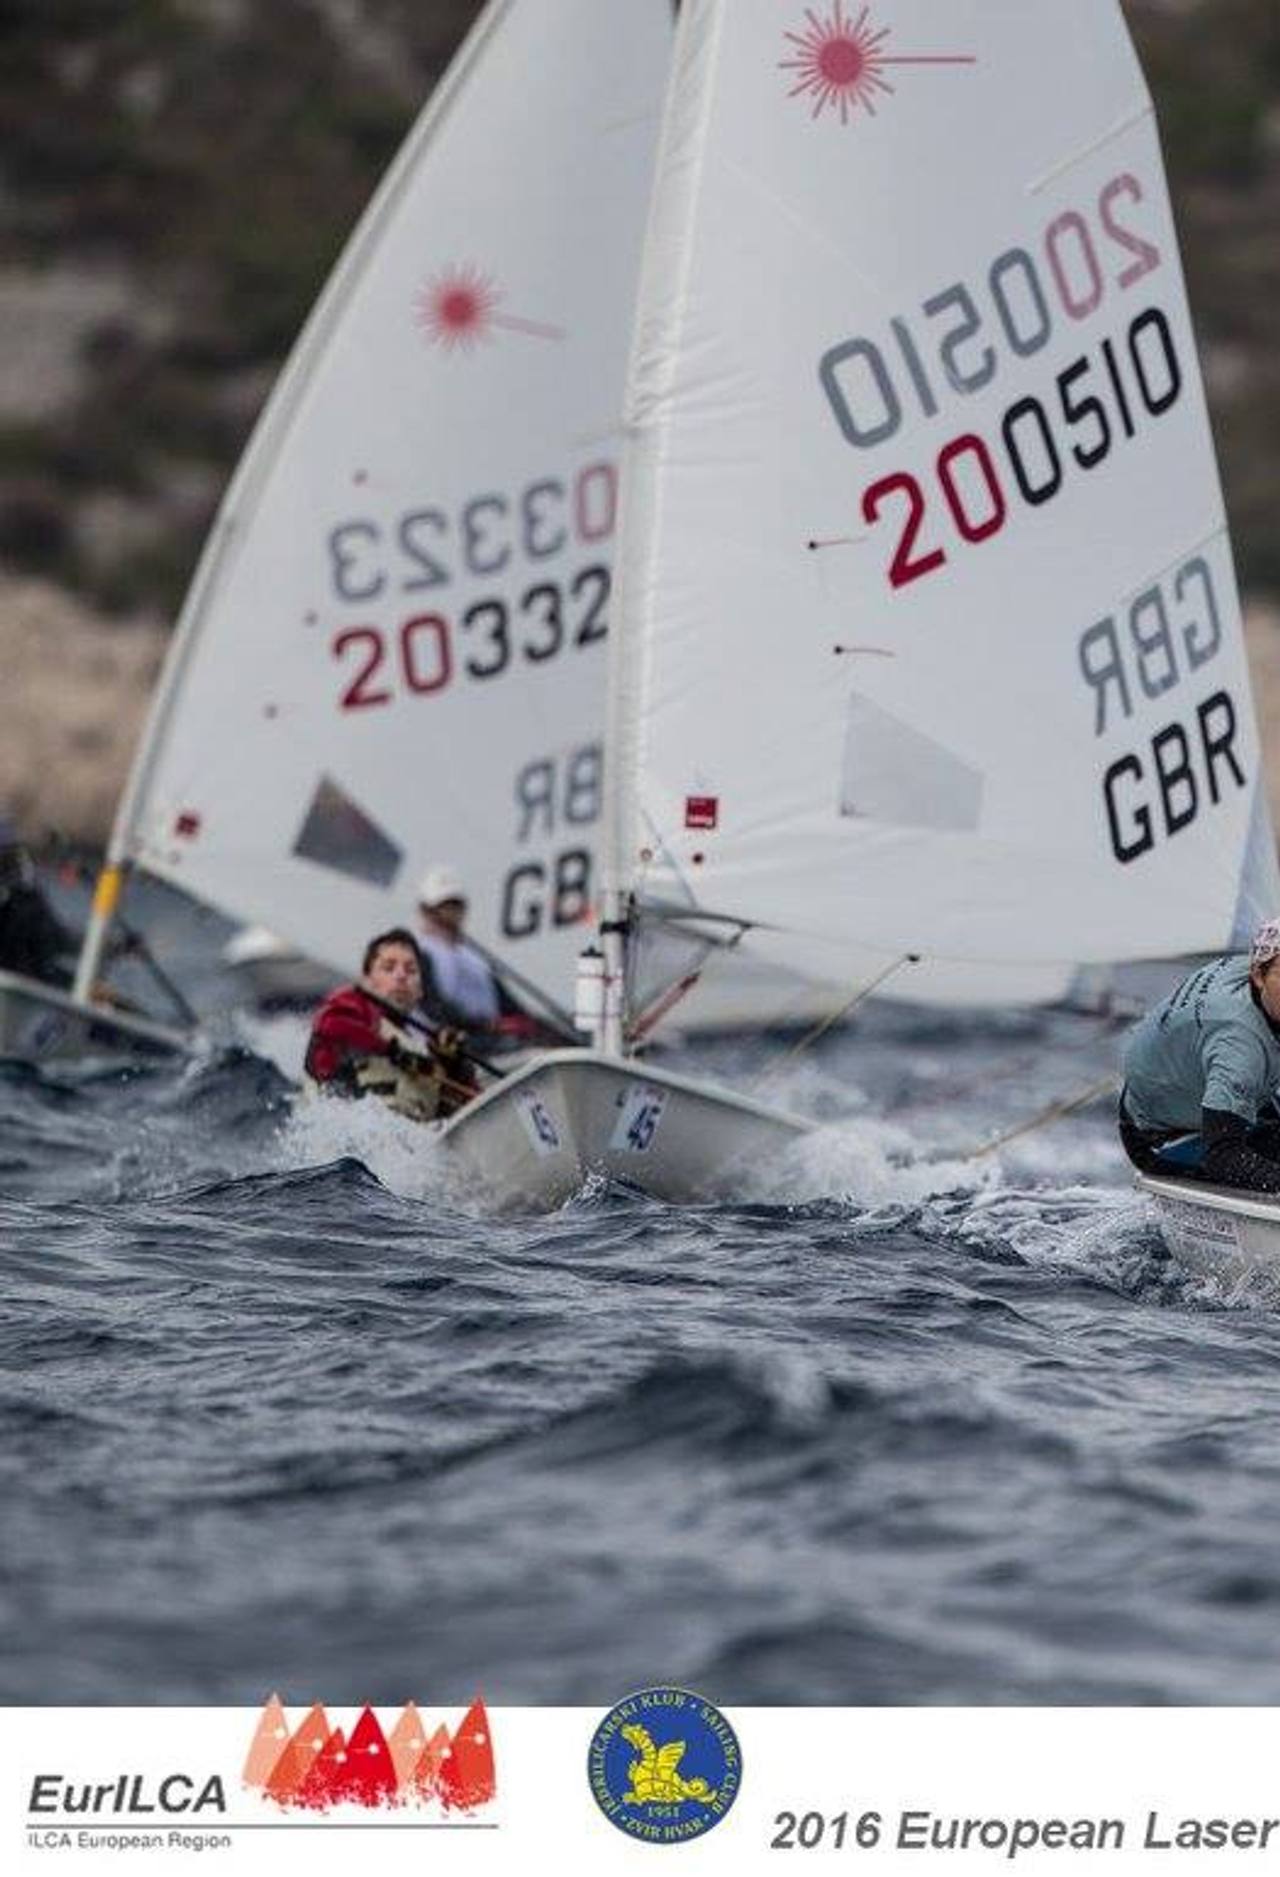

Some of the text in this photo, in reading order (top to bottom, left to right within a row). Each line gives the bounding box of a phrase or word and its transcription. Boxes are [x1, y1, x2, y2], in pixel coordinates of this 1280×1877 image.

[862, 307, 1183, 589] 200510
[332, 563, 612, 715] 20332
[1102, 690, 1246, 864] GBR
[502, 849, 593, 941] GB
